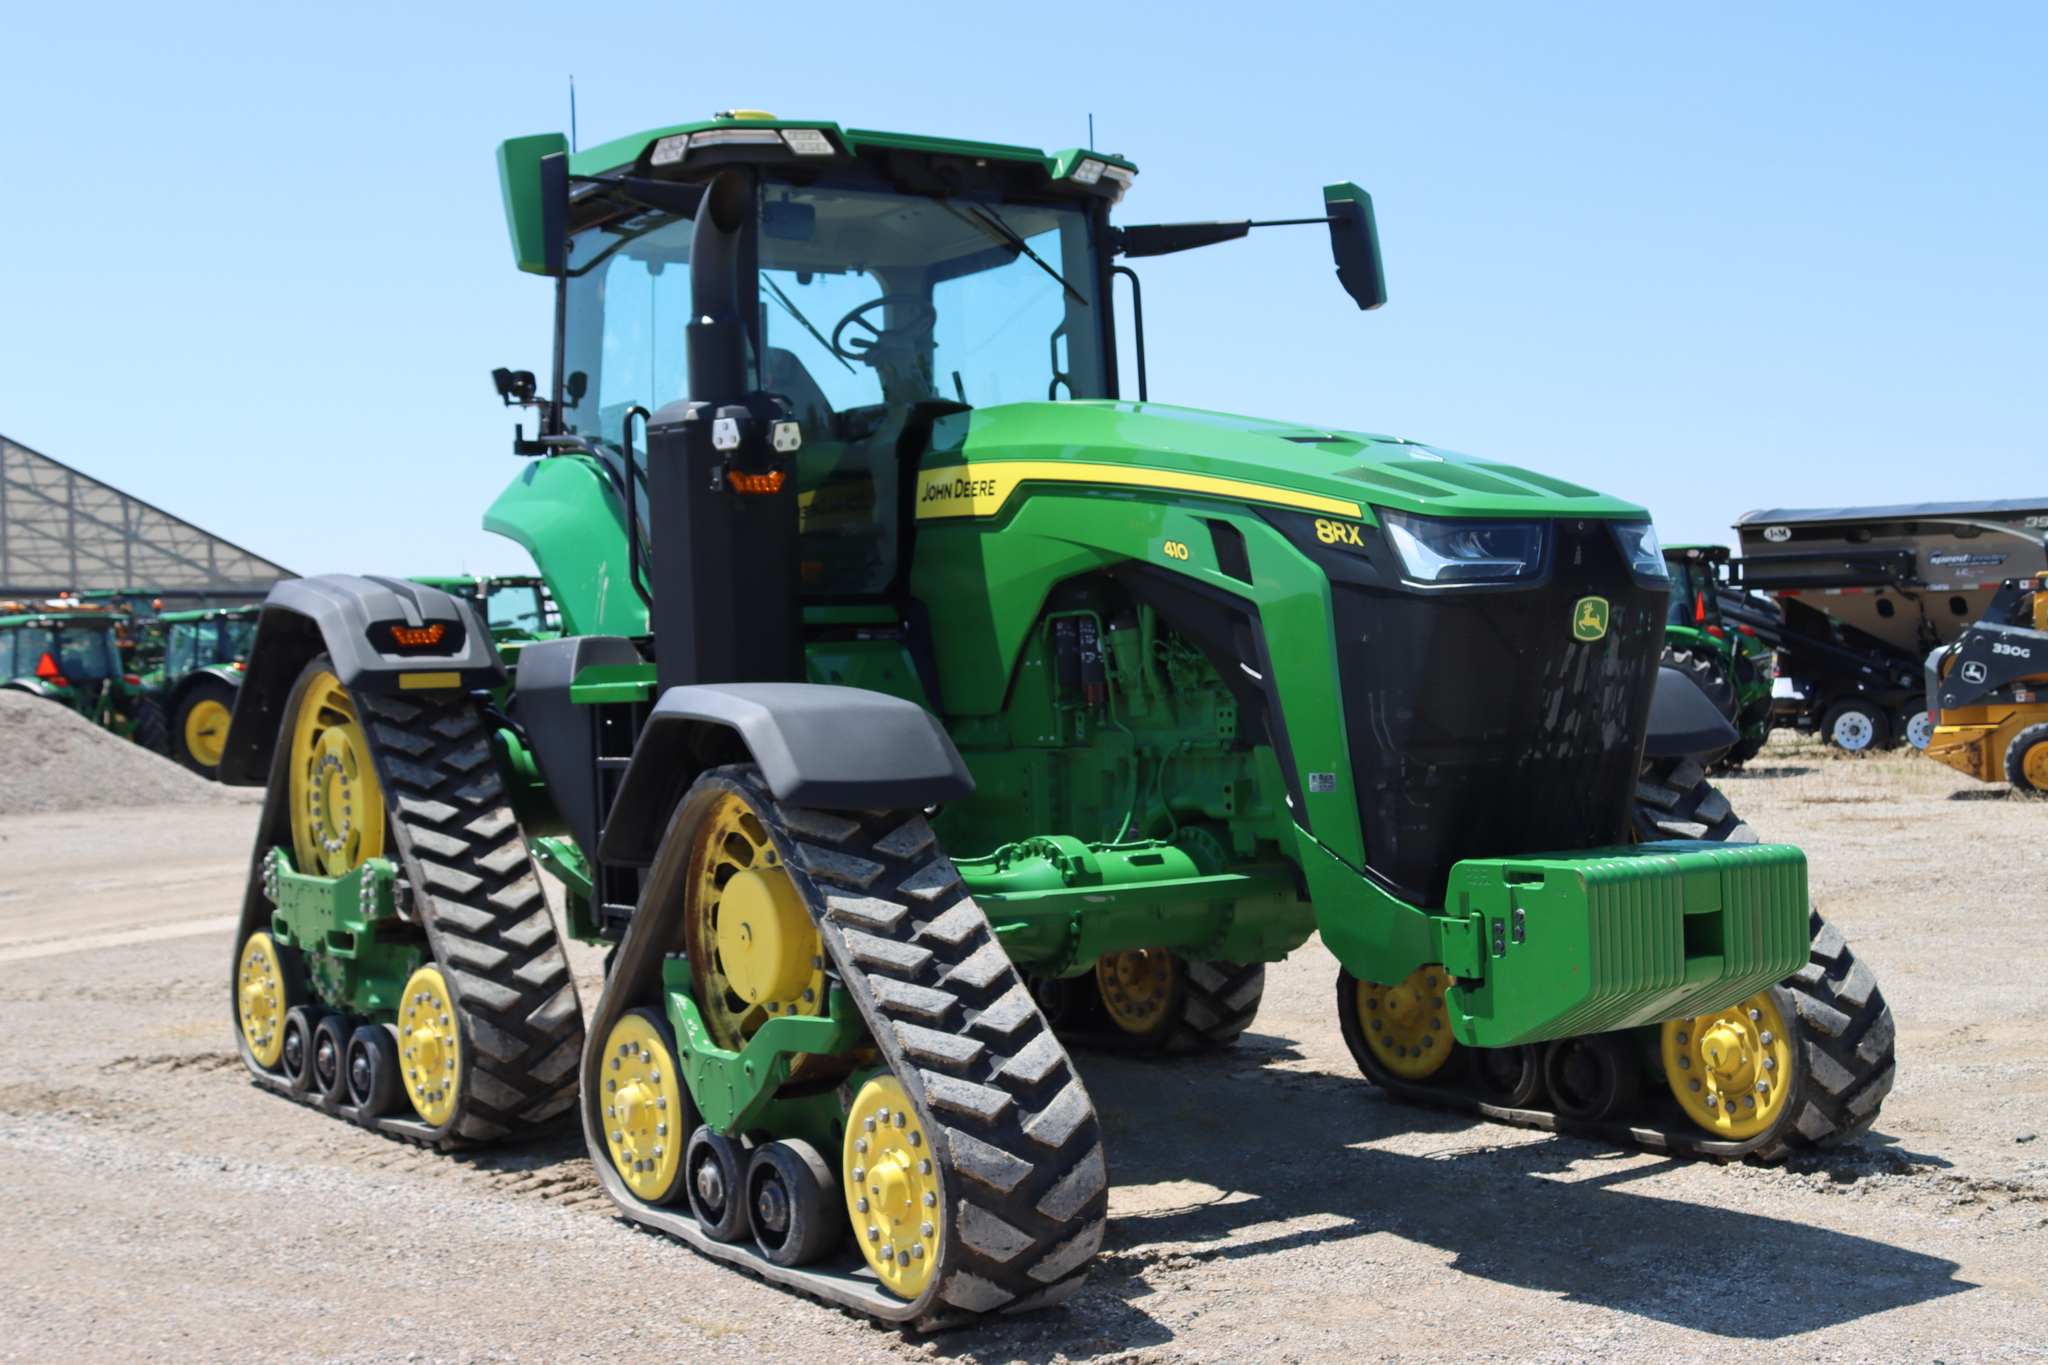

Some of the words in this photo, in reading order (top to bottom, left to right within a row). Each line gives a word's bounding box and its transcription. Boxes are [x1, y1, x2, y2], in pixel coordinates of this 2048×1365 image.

[922, 482, 953, 501] JOHN
[954, 478, 996, 498] DEERE
[1315, 518, 1364, 547] 8RX
[1163, 540, 1189, 561] 410
[1992, 642, 2031, 658] 330G
